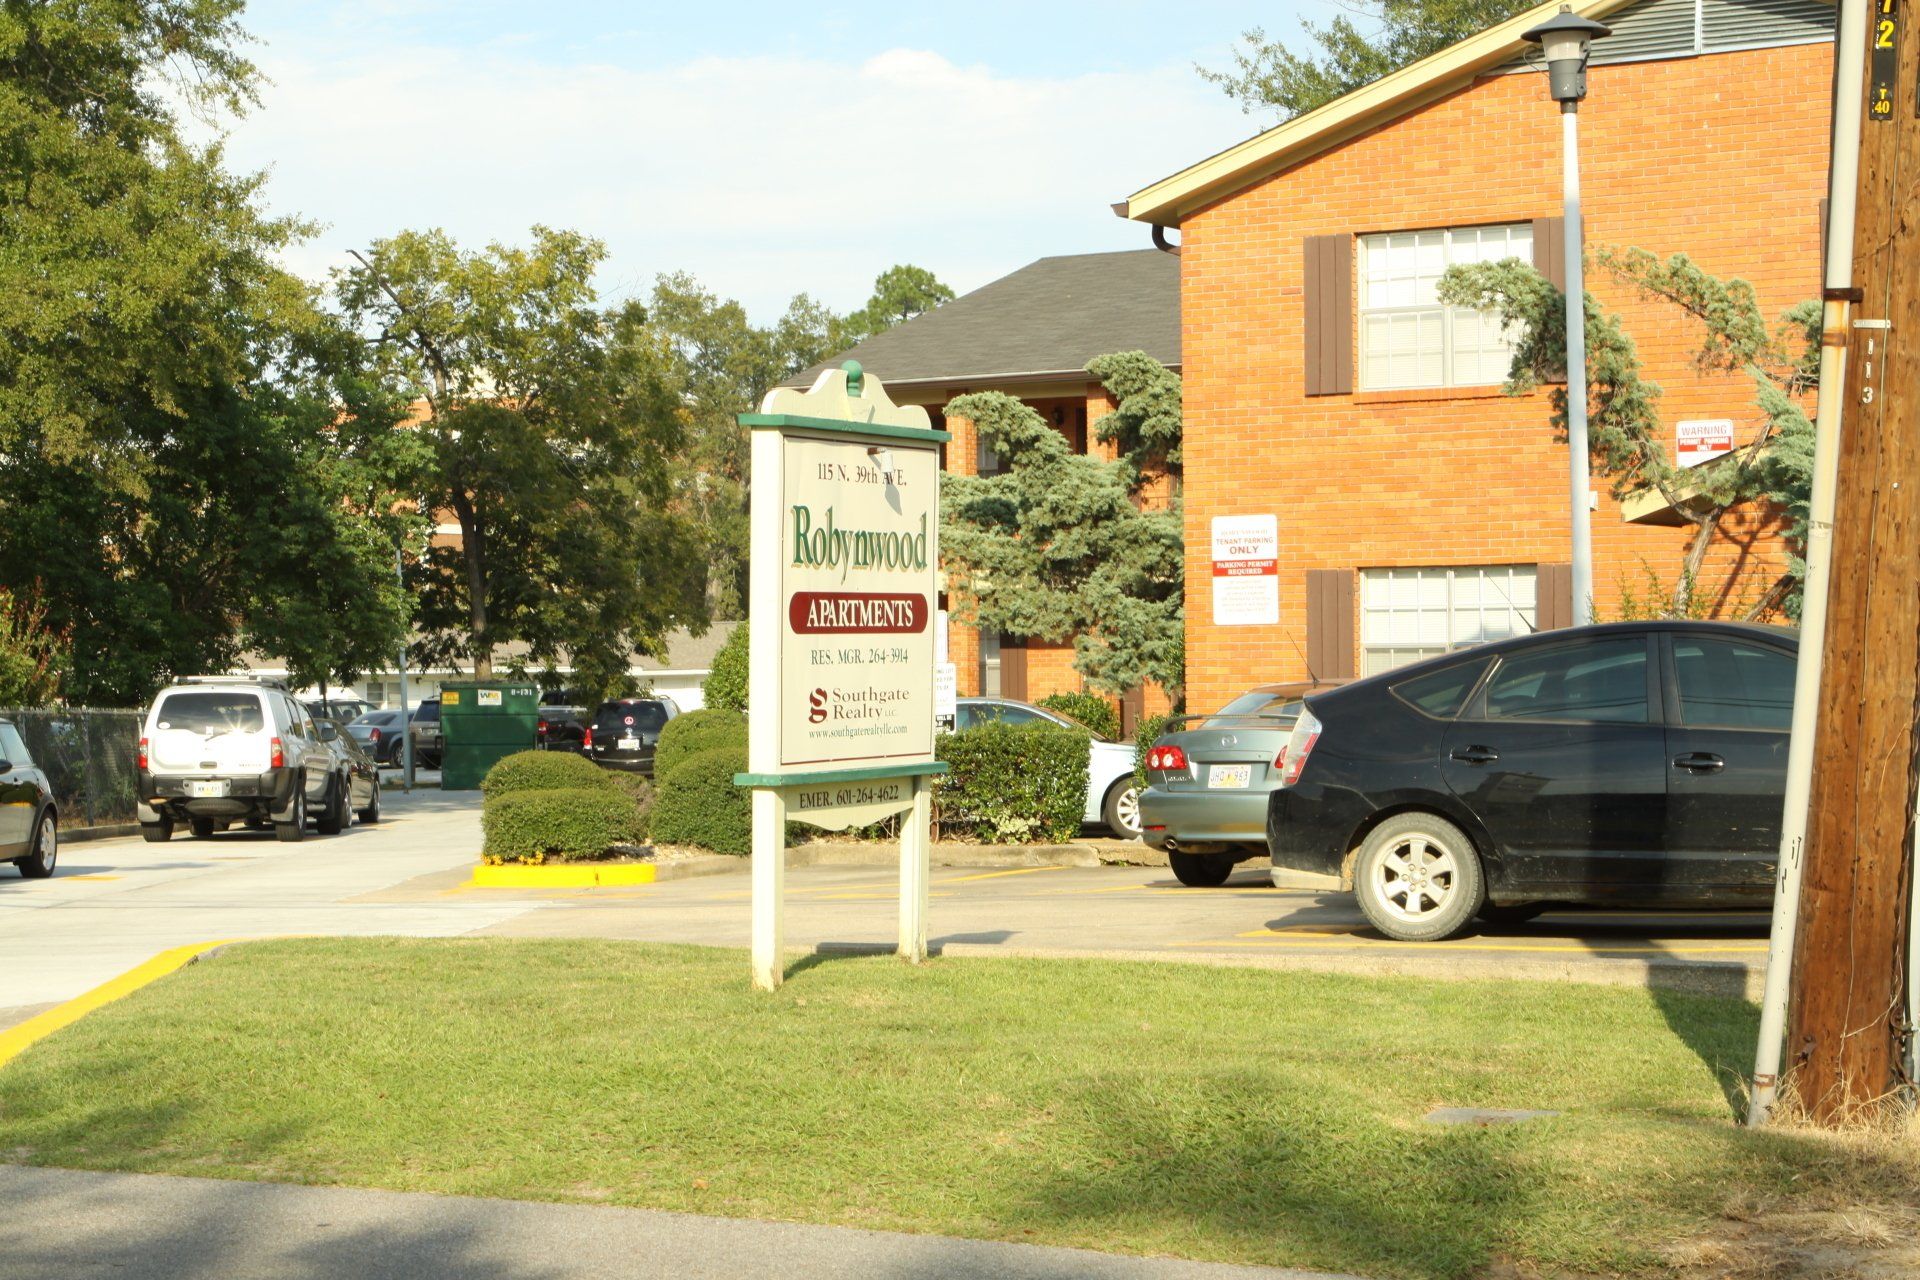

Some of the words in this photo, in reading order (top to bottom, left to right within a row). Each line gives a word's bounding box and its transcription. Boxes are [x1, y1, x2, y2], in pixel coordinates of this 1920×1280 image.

[1879, 88, 1887, 100] T
[1874, 100, 1890, 114] 40
[1682, 425, 1727, 435] WARNING
[817, 462, 833, 481] 115
[837, 464, 850, 483] N.
[854, 465, 878, 484] 39th
[882, 468, 907, 486] AVE.
[791, 504, 928, 585] Robynwood
[1230, 546, 1259, 554] ONLY
[806, 599, 914, 628] APARTMENTS
[811, 649, 834, 666] RES.
[838, 648, 865, 665] MGR.
[868, 647, 908, 665] 264-3914
[832, 686, 910, 703] Southgate
[833, 703, 884, 721] Realty
[808, 723, 908, 740] www.southgaterealtyllc.com
[799, 790, 833, 809] EMER.
[836, 784, 899, 806] 601-264-4622
